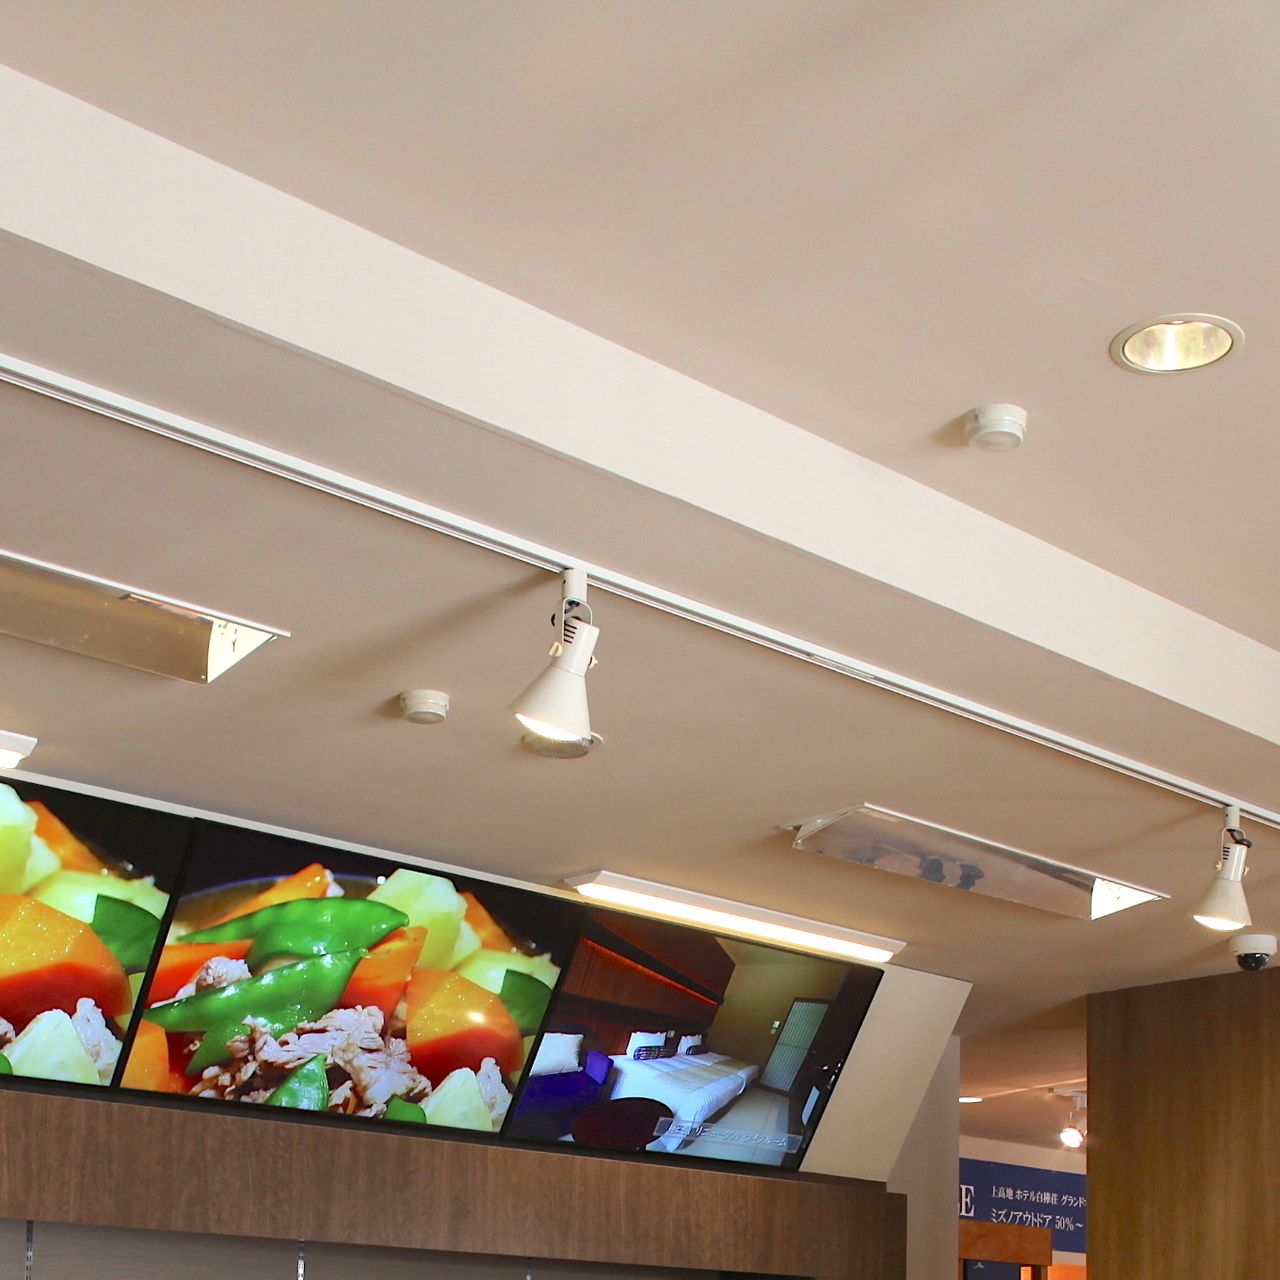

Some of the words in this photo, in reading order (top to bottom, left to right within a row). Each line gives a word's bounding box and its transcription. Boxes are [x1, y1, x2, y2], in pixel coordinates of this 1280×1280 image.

[991, 1185, 1013, 1200] 上高地
[1061, 1195, 1087, 1208] グランド
[991, 1208, 1052, 1228] ミズノアウトドア
